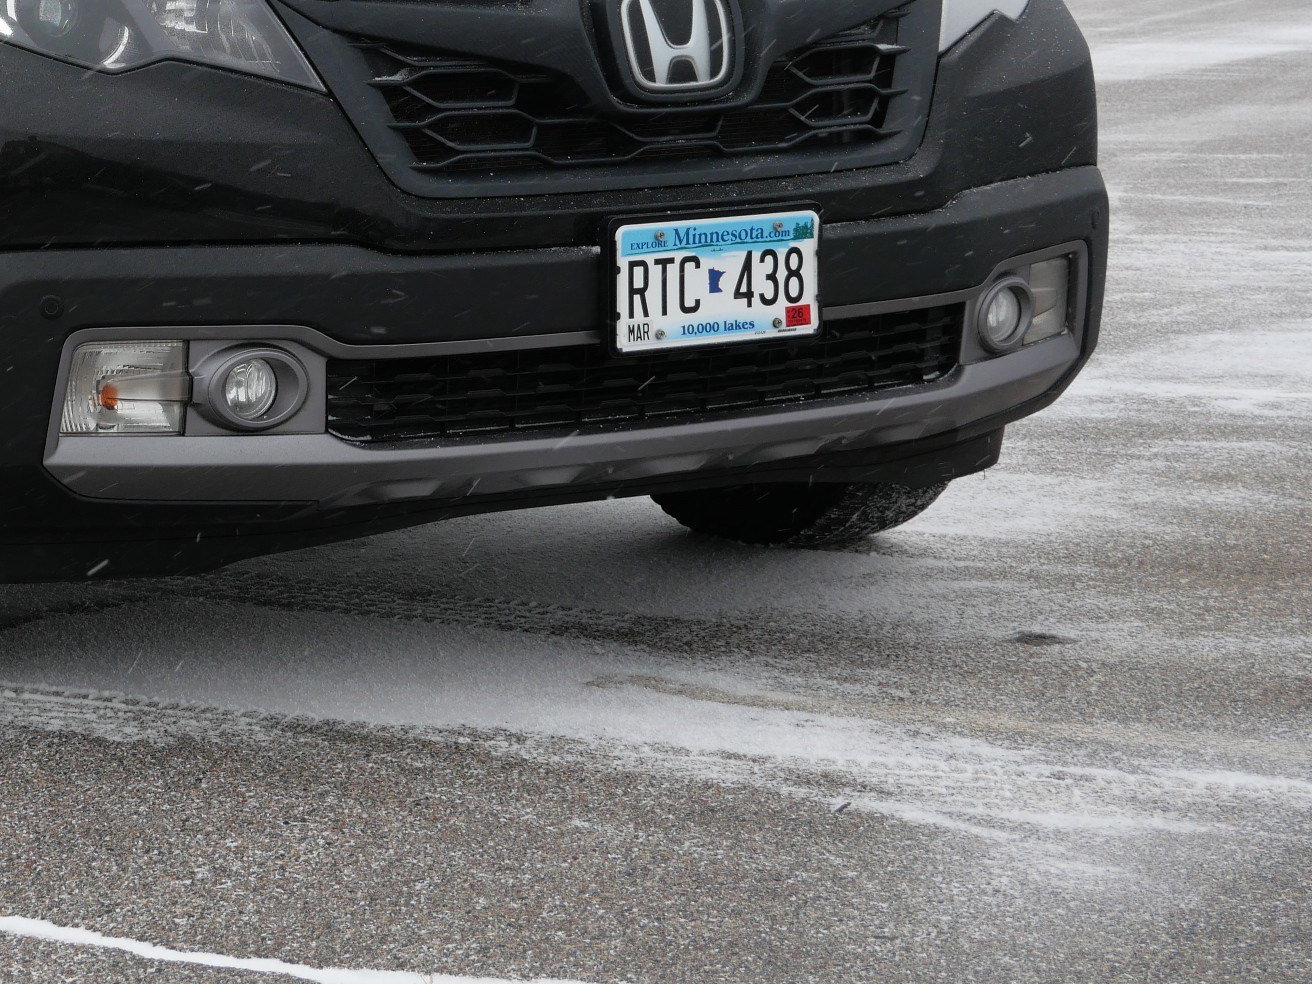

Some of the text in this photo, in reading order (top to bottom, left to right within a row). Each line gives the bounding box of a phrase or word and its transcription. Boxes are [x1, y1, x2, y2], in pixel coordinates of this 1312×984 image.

[630, 238, 669, 251] EXPLORE
[628, 246, 804, 319] RTC 438
[628, 323, 650, 342] MAR
[680, 320, 755, 336] 10,000 lakes
